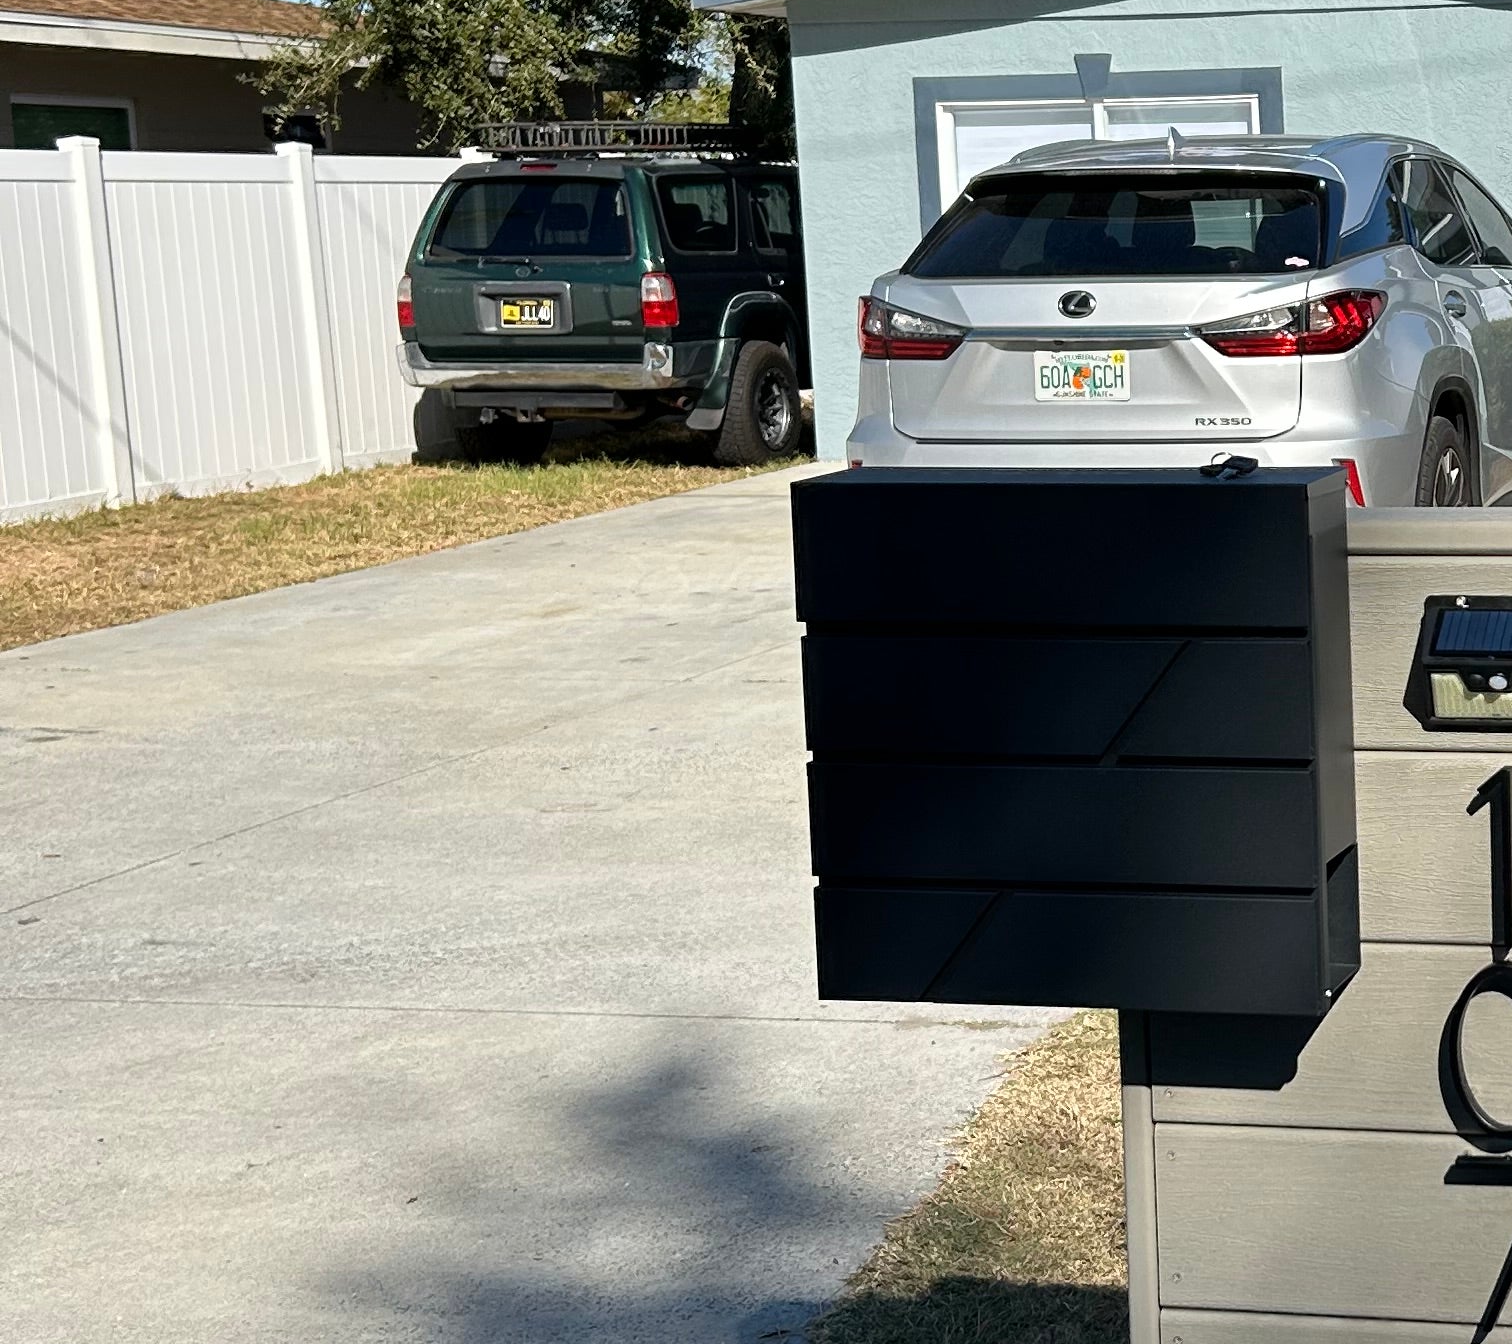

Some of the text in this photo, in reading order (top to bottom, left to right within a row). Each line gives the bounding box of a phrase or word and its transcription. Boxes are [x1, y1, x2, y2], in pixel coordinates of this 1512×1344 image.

[1092, 364, 1124, 389] GCH
[1194, 417, 1252, 427] RX 350
